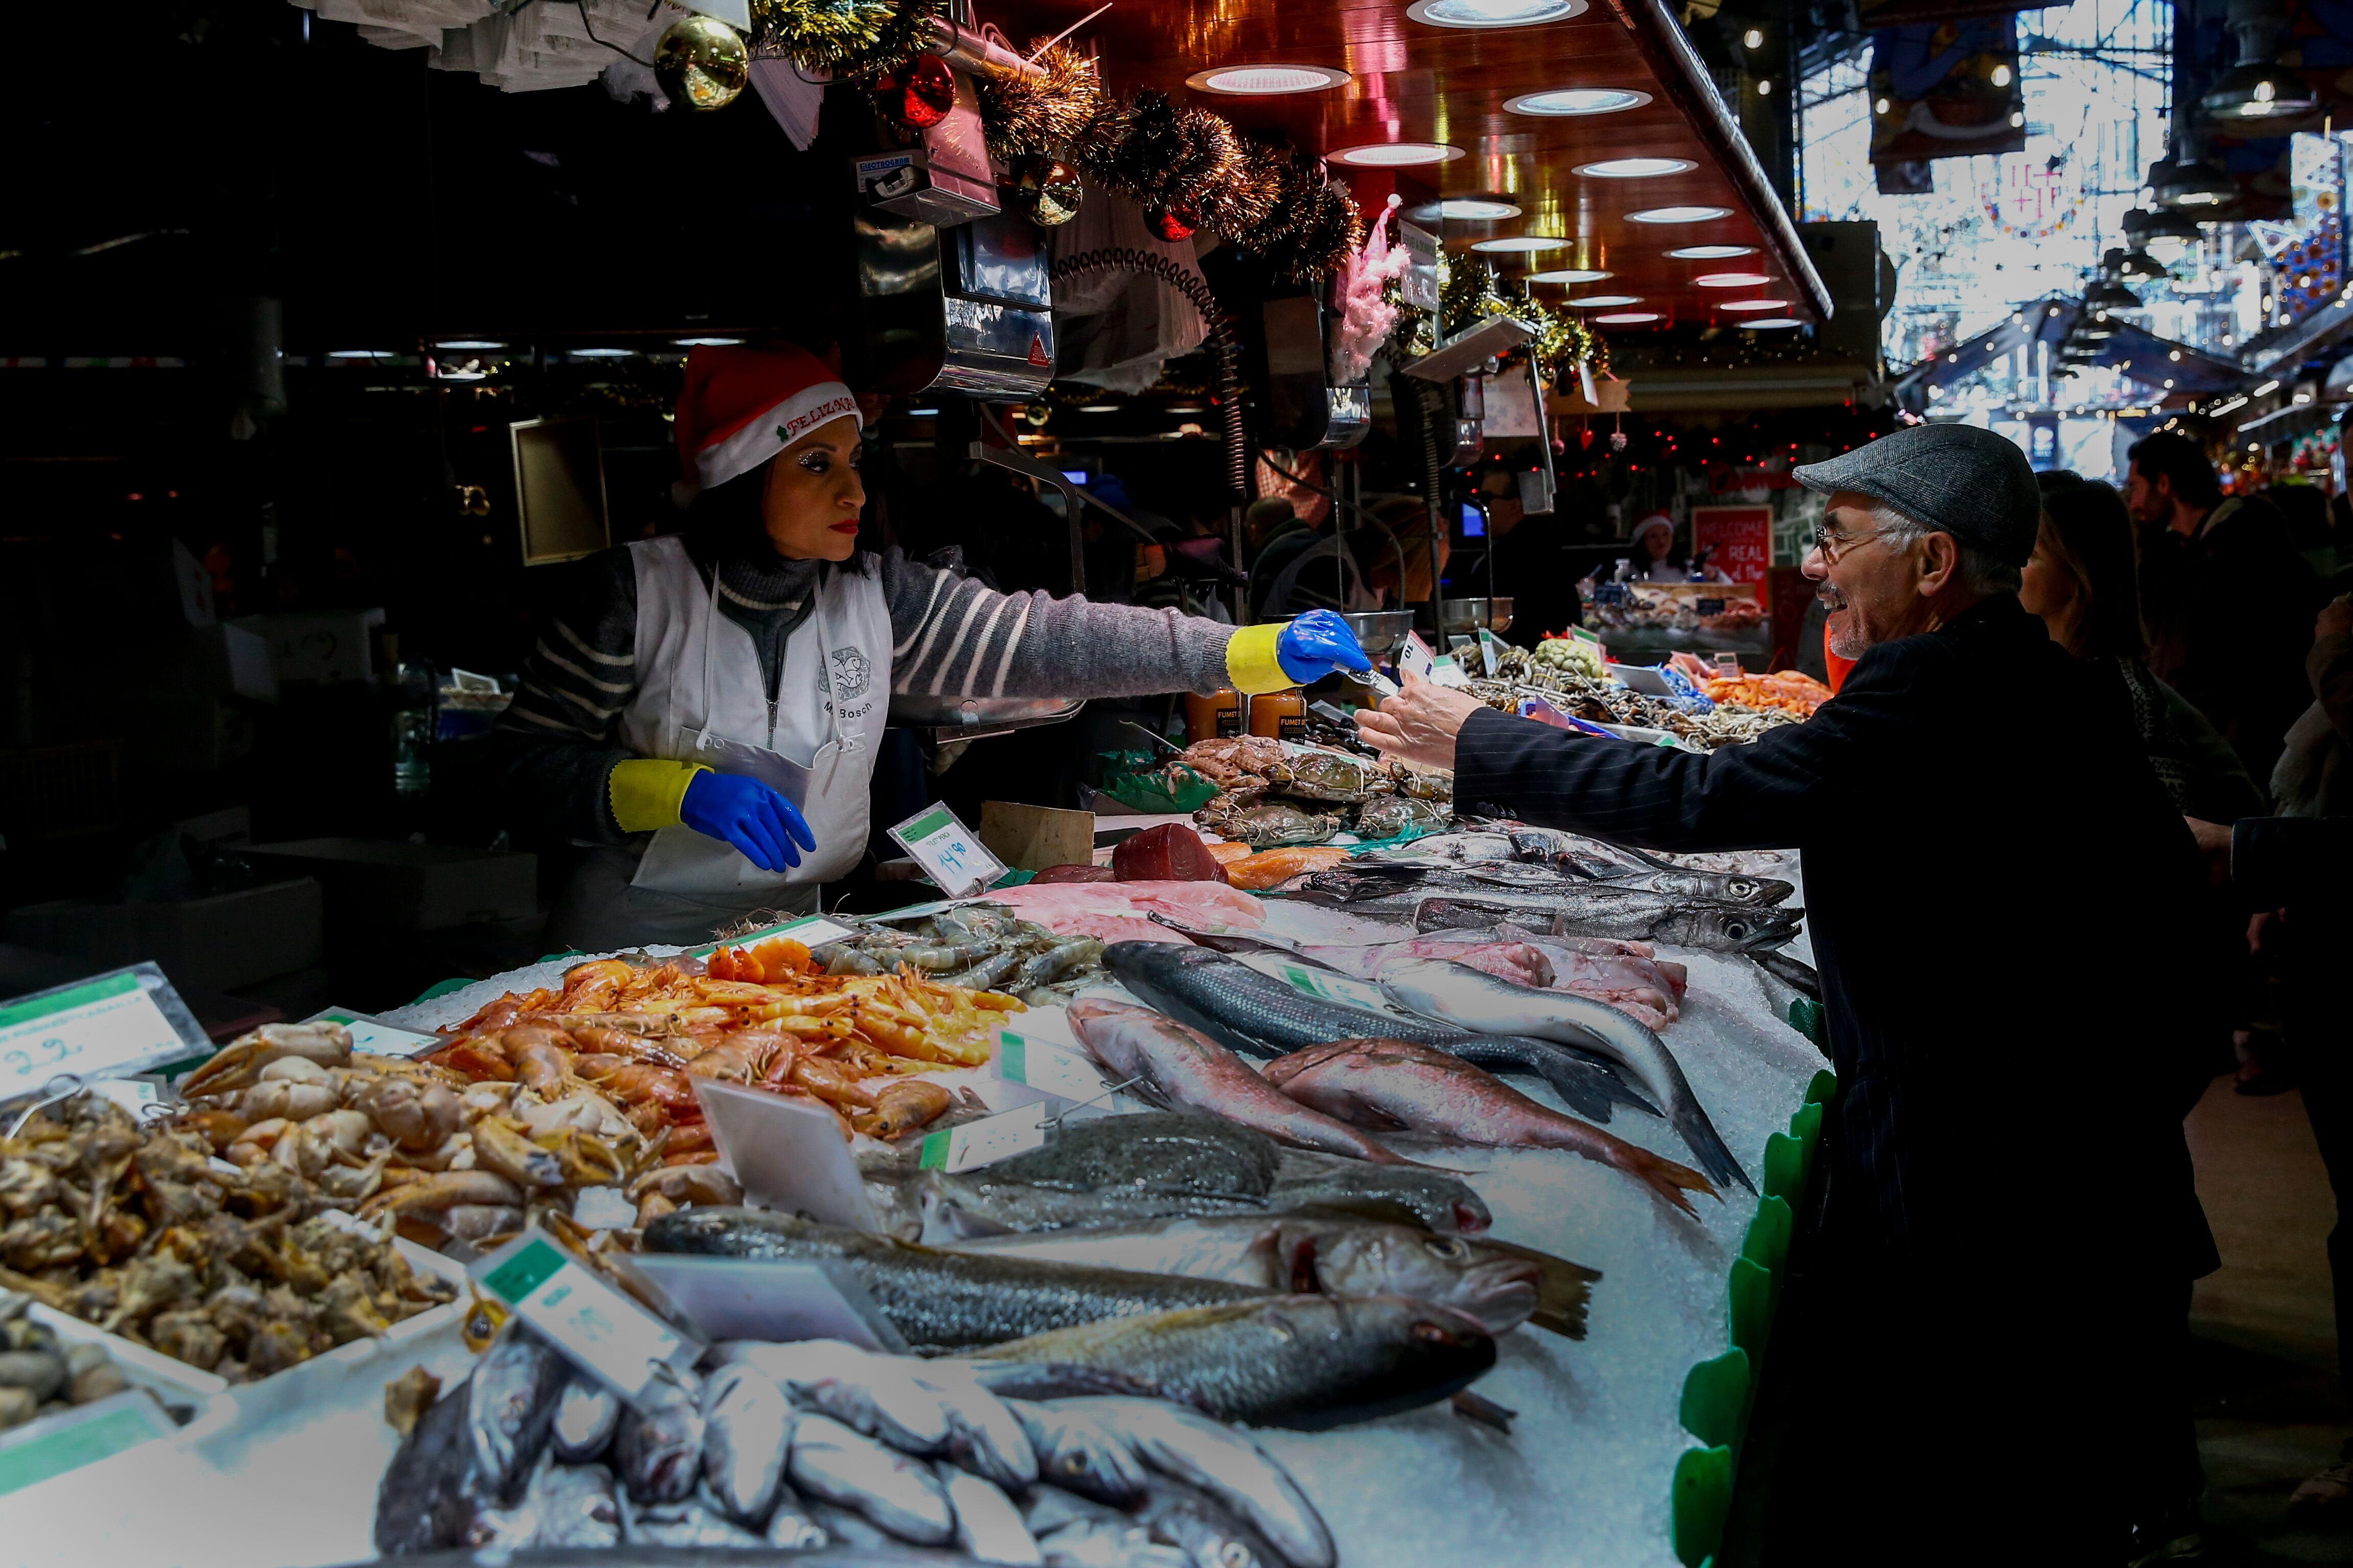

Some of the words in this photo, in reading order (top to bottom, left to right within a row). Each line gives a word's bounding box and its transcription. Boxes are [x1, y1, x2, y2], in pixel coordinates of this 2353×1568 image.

[860, 157, 910, 171] ELECTROGRAM
[787, 402, 835, 436] FELIZ
[834, 397, 855, 411] NA
[1729, 545, 1765, 562] REAL
[1405, 644, 1414, 660] 10
[840, 703, 872, 718] Bosch
